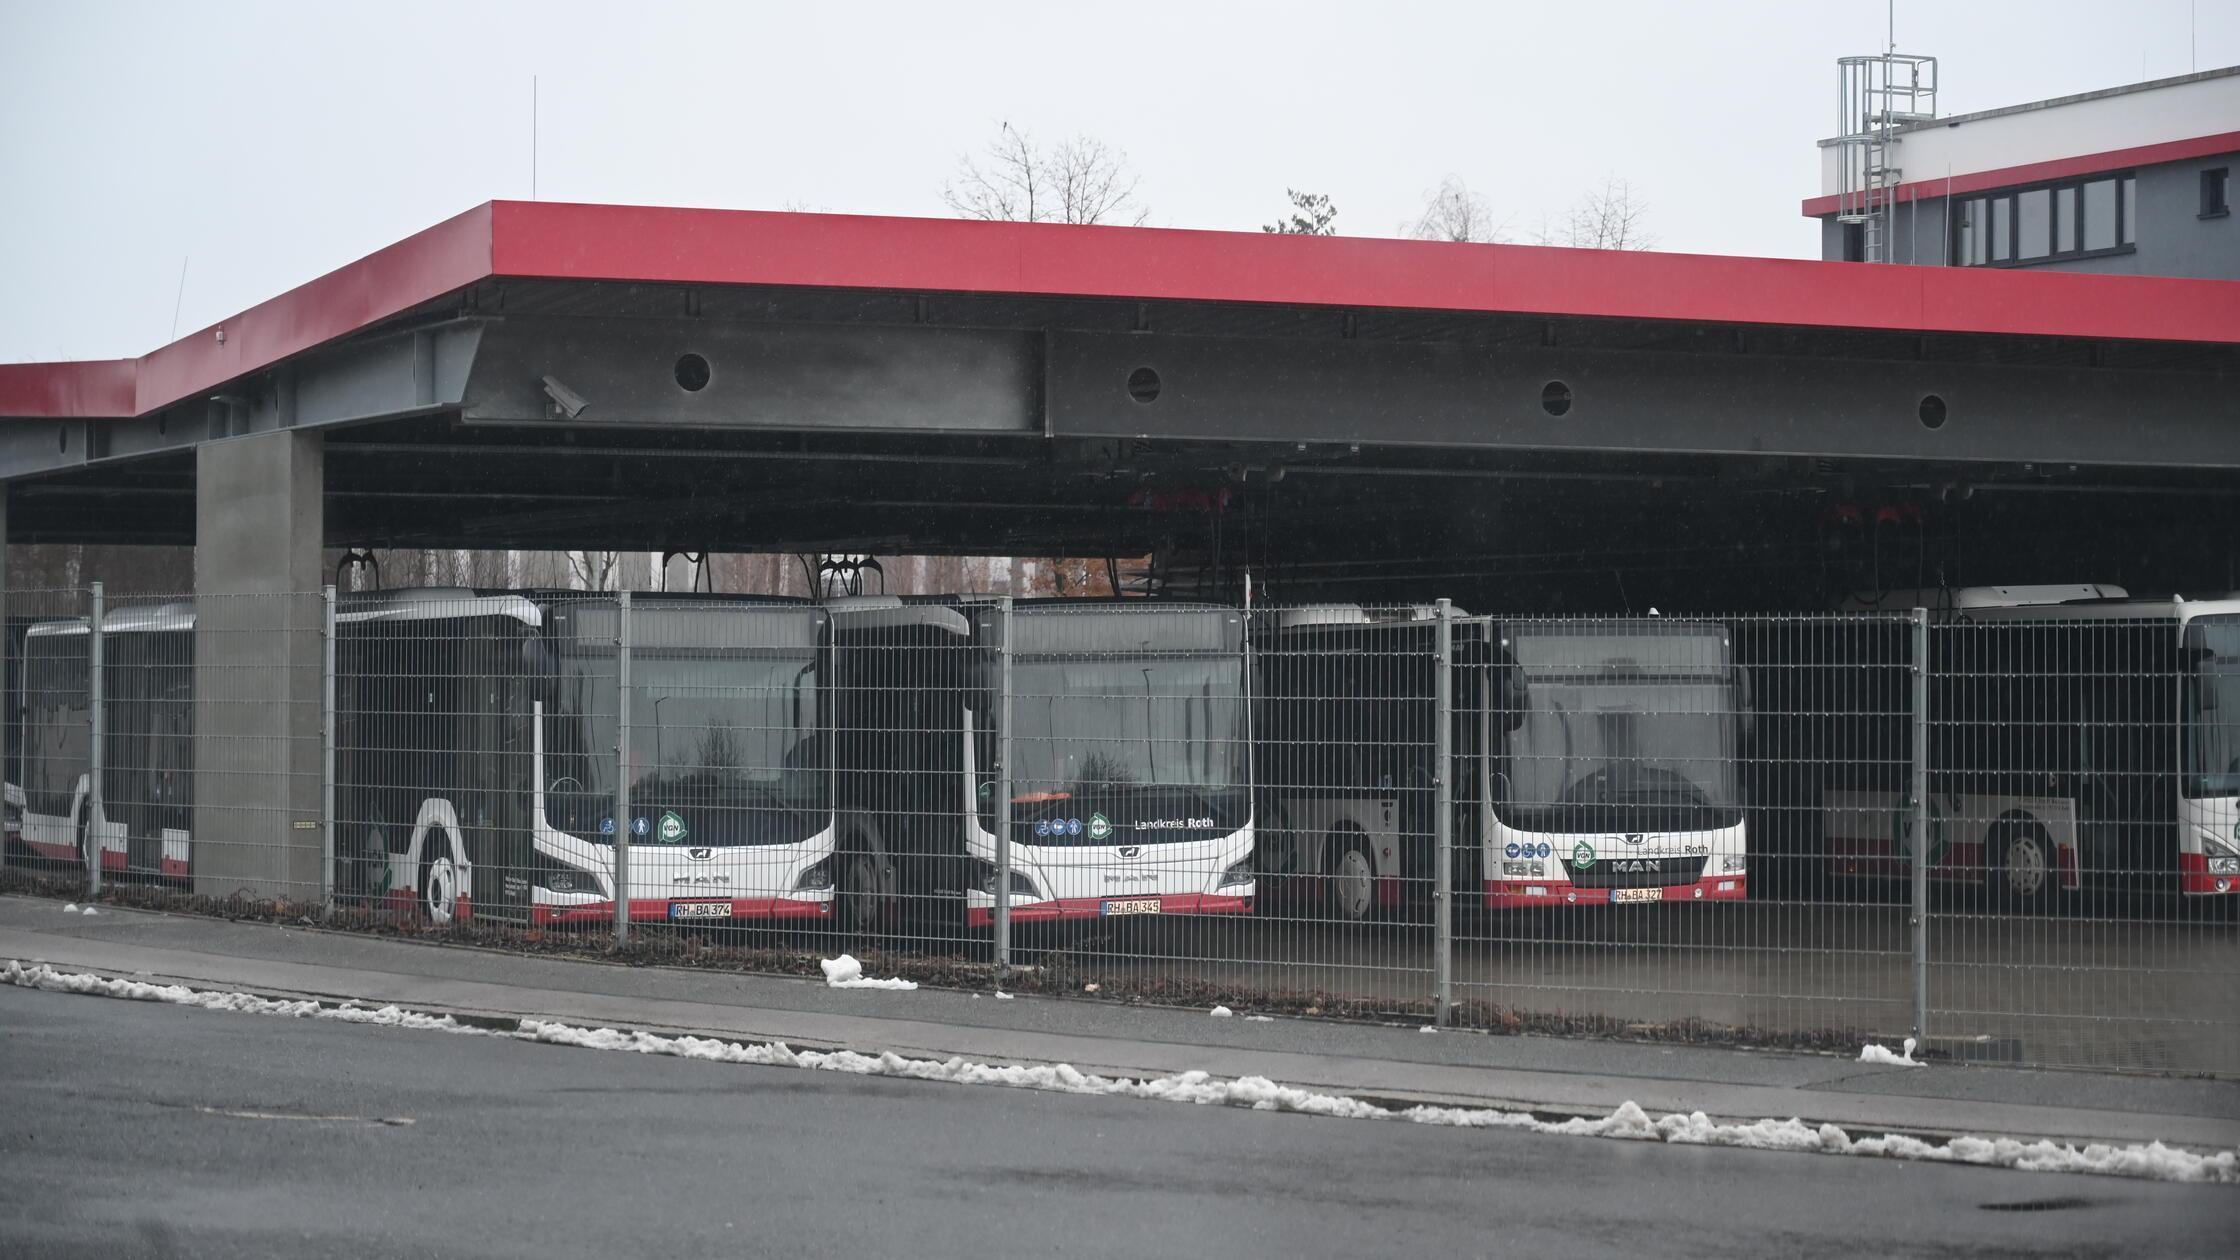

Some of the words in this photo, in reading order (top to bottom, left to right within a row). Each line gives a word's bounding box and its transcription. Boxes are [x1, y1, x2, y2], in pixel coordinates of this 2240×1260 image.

[664, 824, 679, 832] VGN
[1135, 819, 1184, 830] Landkreis
[1187, 817, 1214, 829] Roth
[1637, 843, 1681, 856] Landkreis
[1684, 844, 1709, 854] Roth
[1612, 860, 1660, 873] MAN
[1616, 889, 1628, 900] RH
[1632, 889, 1644, 900] BA
[1646, 888, 1662, 900] 327
[676, 904, 690, 916] RH
[696, 904, 710, 916] BA
[711, 904, 730, 916] 374
[1107, 903, 1120, 914] RH
[1126, 902, 1139, 912] BA
[1141, 901, 1159, 912] 345
